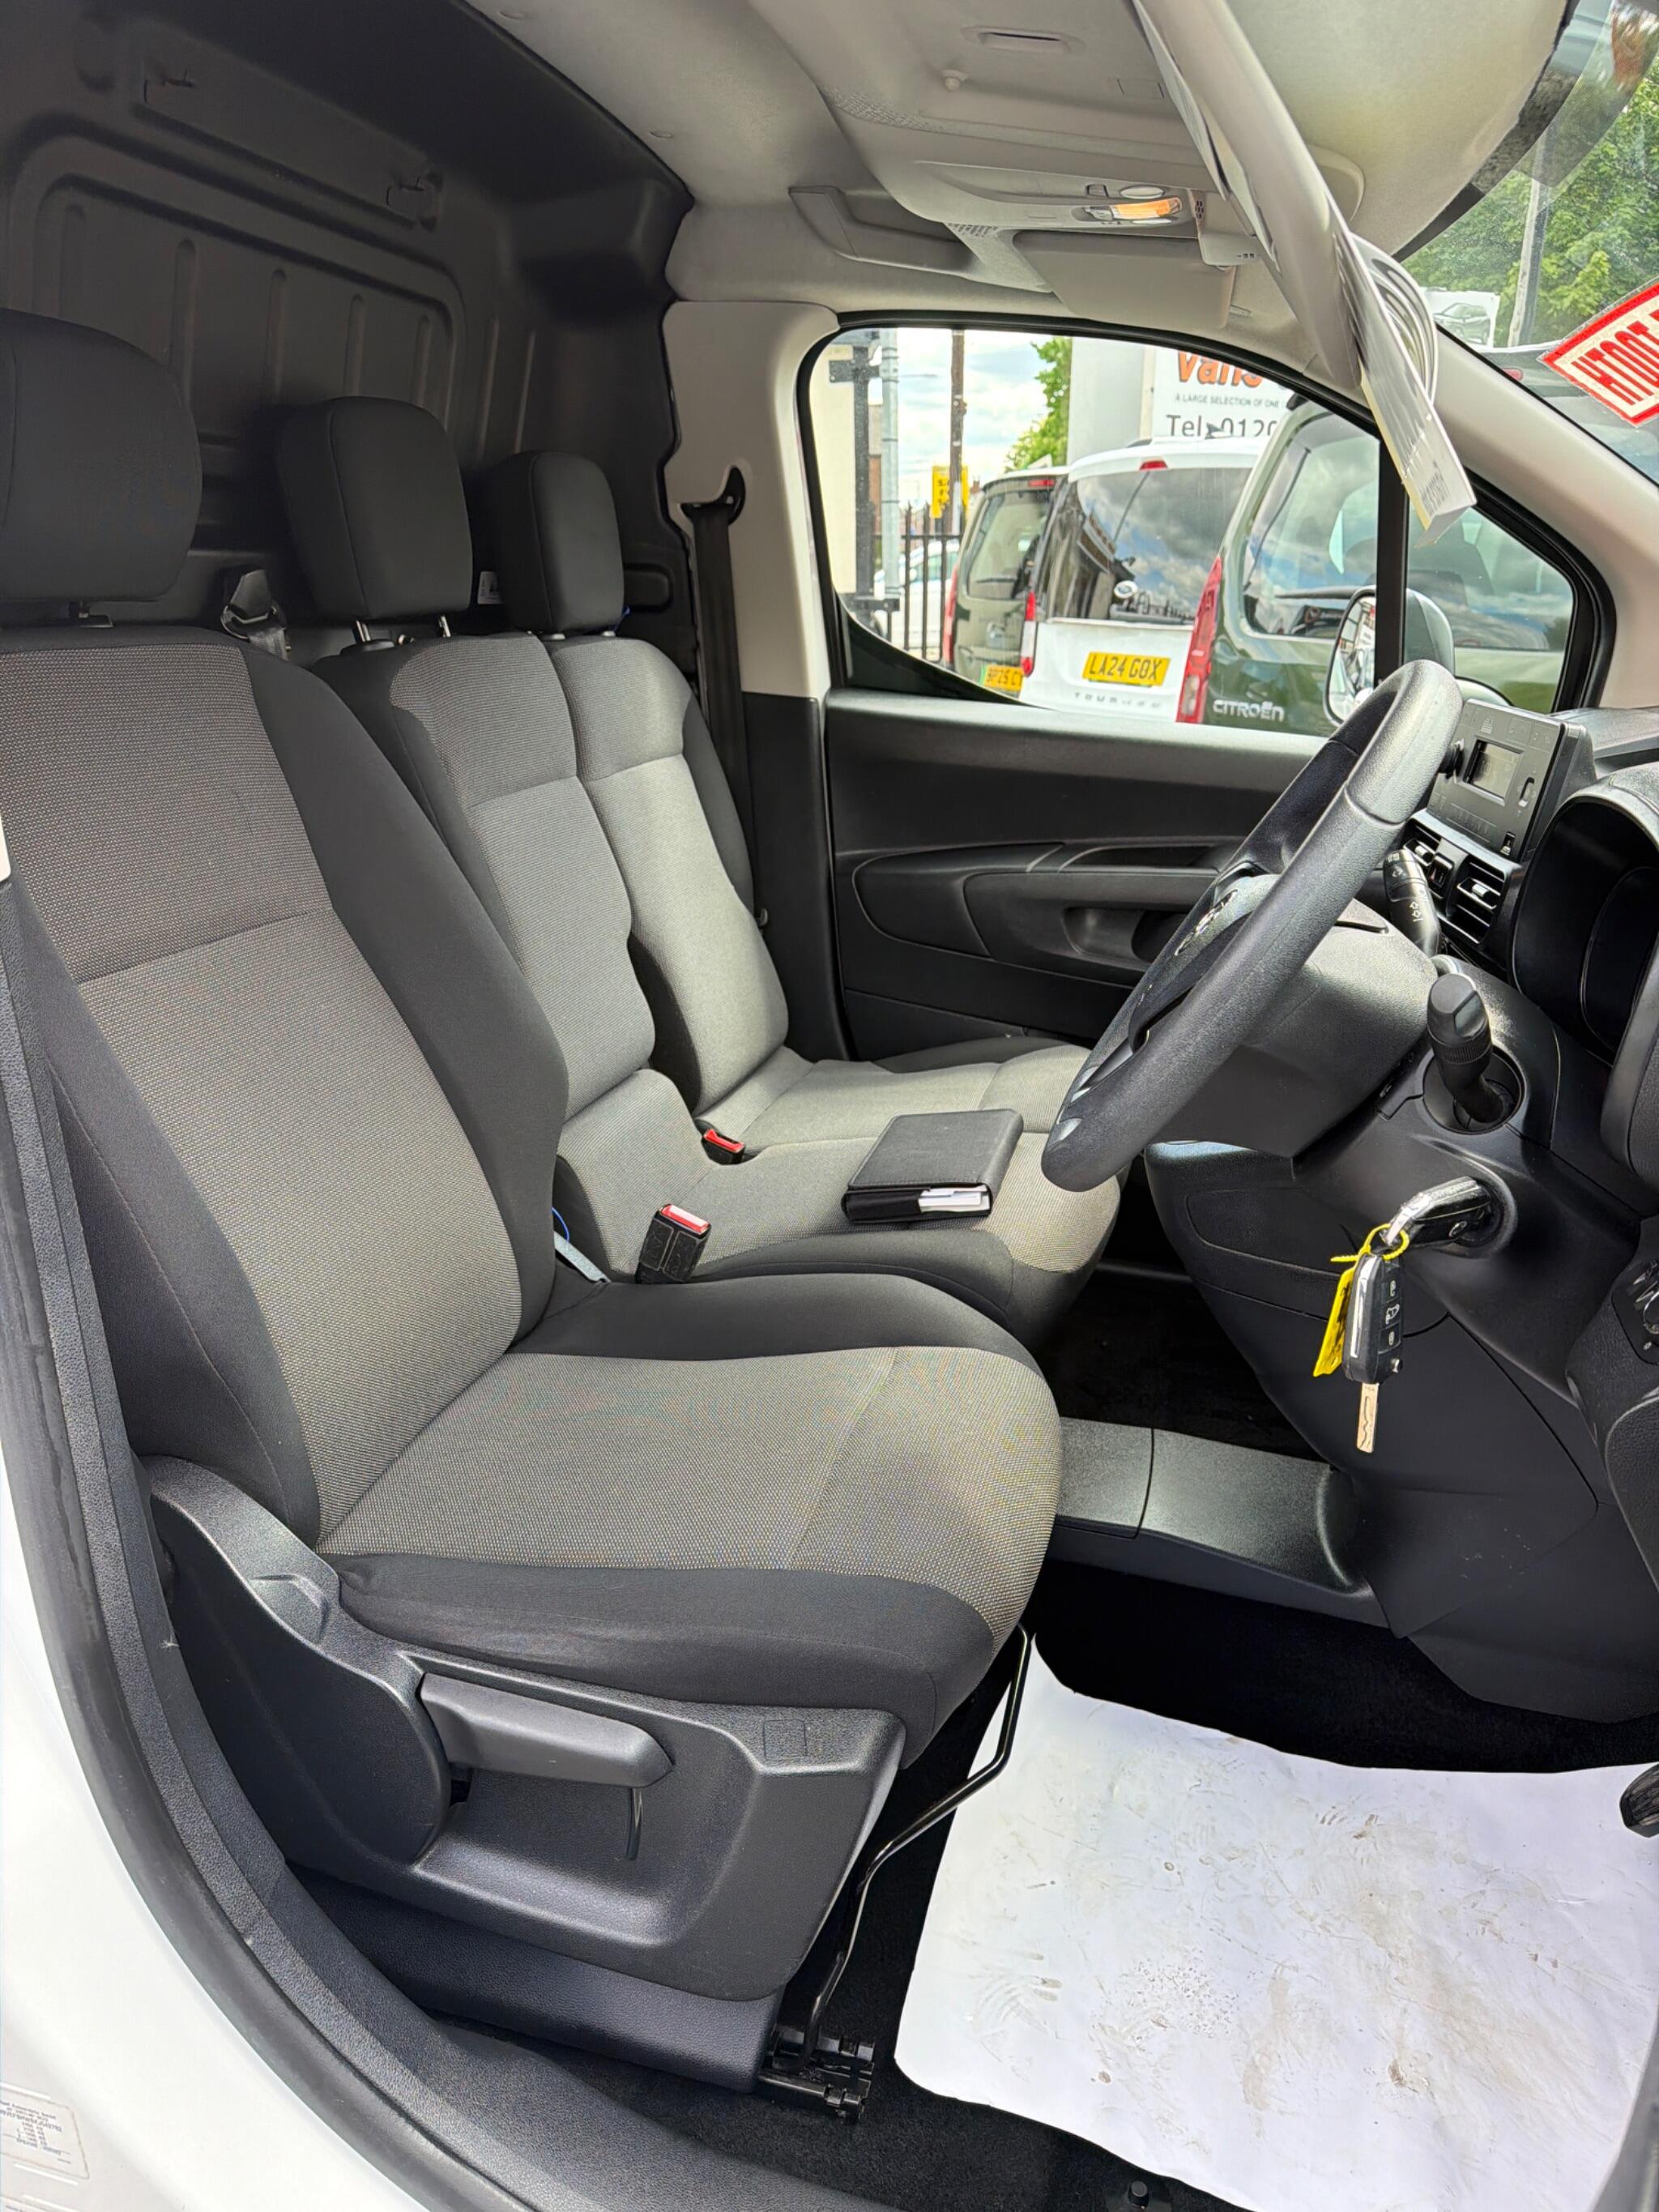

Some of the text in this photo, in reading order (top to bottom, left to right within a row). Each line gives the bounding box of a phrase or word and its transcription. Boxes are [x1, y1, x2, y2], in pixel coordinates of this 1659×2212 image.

[1183, 394, 1208, 404] LARGE
[1210, 395, 1252, 406] SELECTION
[1253, 398, 1263, 407] OF
[1089, 654, 1128, 677] LA24
